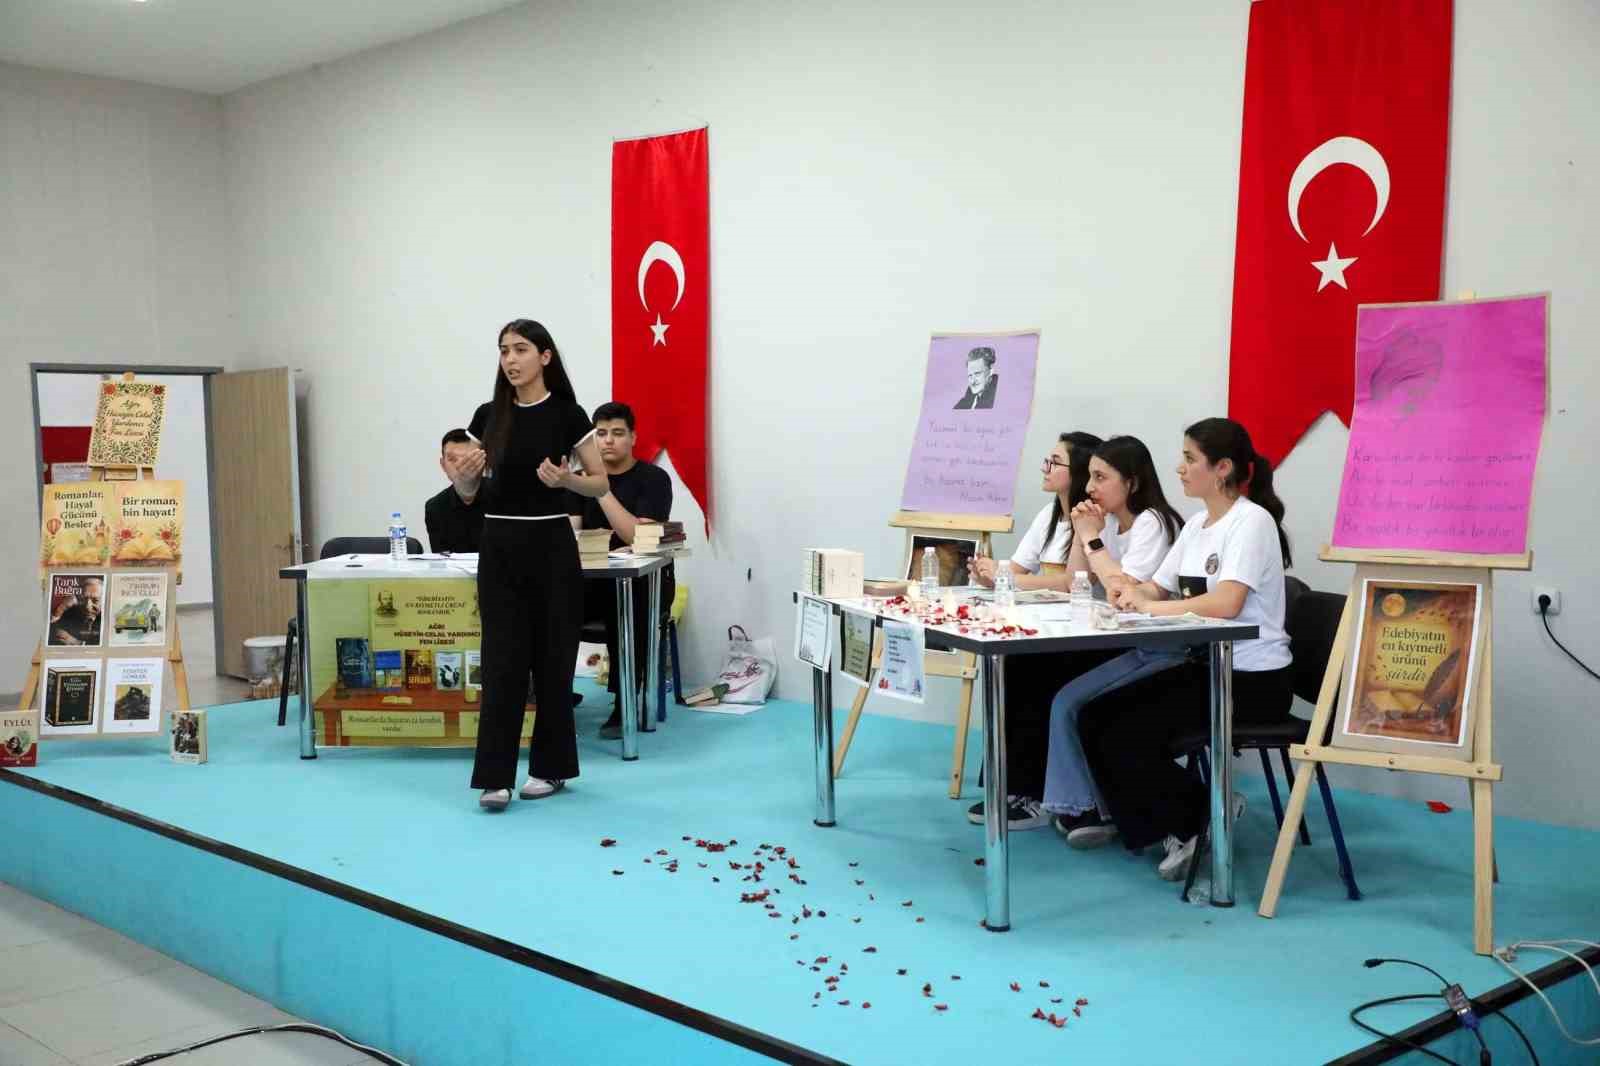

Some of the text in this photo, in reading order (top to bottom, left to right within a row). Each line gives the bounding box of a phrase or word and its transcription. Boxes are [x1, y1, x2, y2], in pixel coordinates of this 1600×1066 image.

[65, 501, 93, 510] Hayal
[122, 497, 179, 507] Bir roman,
[60, 511, 98, 520] Gücünü
[122, 507, 176, 519] bin hayat!
[64, 520, 93, 530] Besler
[54, 577, 80, 587] Tarık
[54, 587, 83, 597] Buğra
[1381, 641, 1448, 656] en kıymetli
[1391, 654, 1427, 665] ürünü
